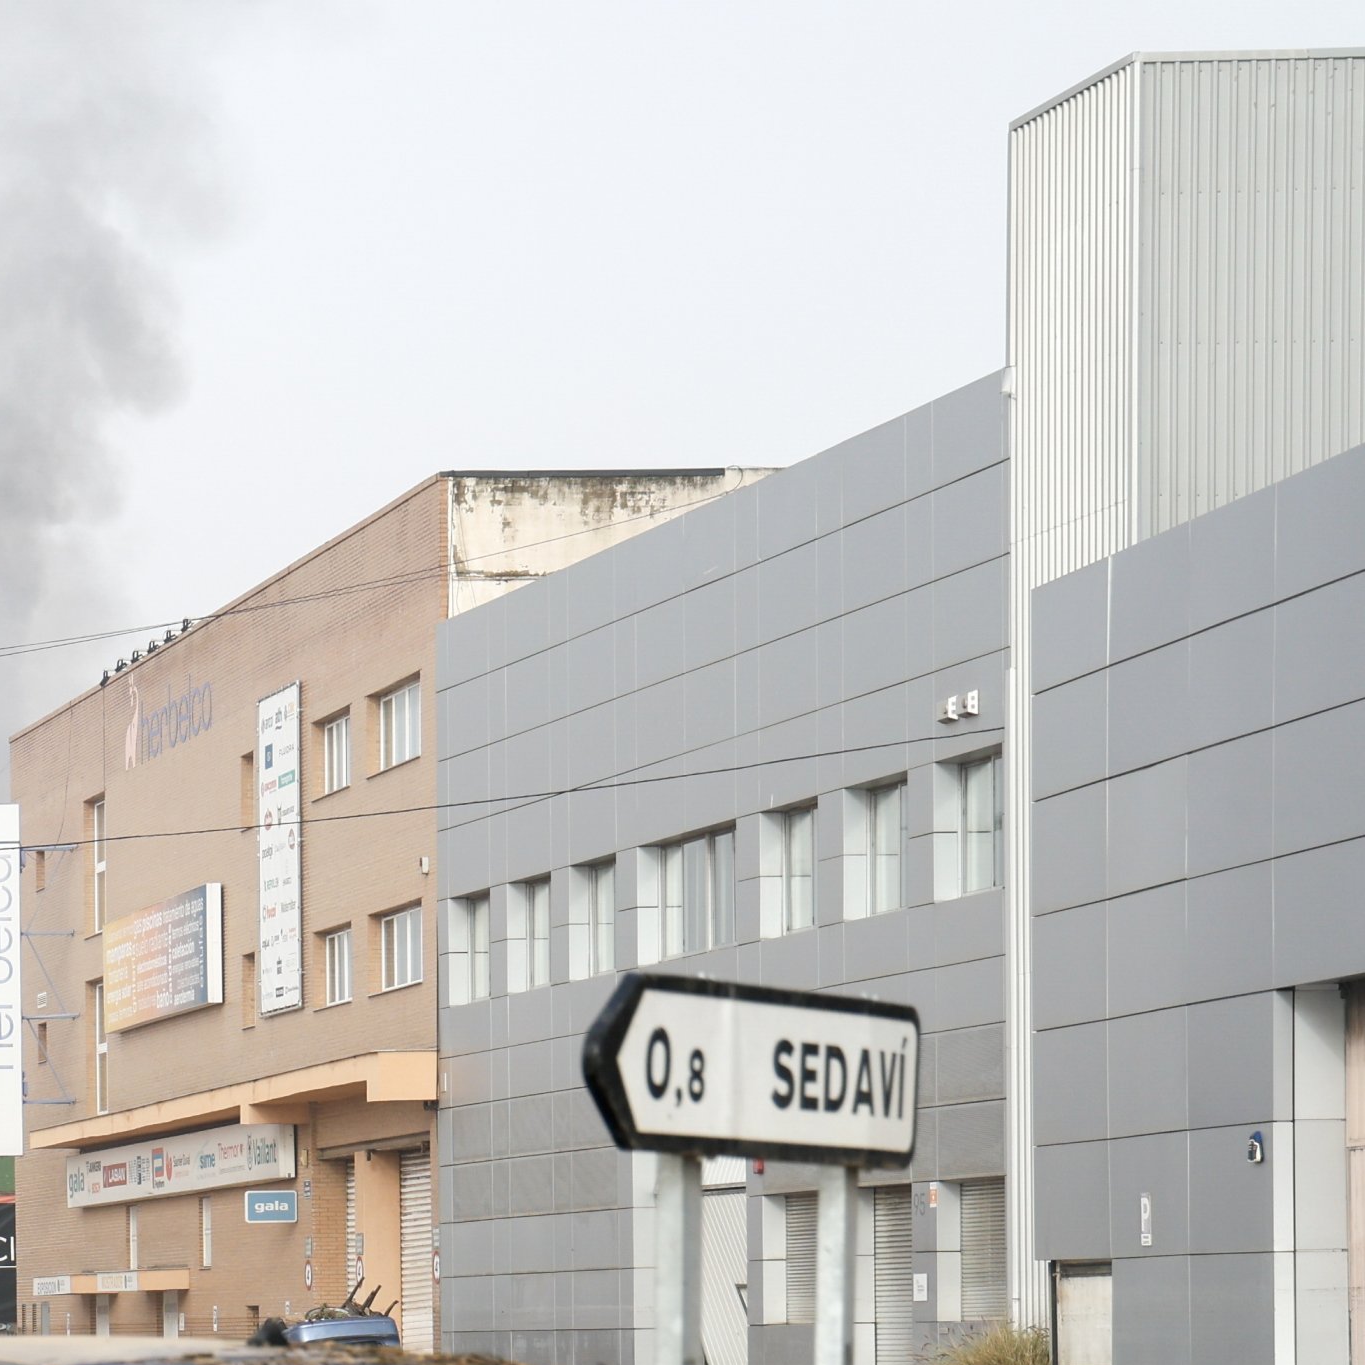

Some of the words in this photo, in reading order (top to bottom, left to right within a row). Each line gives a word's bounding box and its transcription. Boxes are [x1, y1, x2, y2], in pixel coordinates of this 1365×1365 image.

[140, 672, 212, 765] herbelca
[646, 1027, 705, 1107] 0,8
[771, 1036, 908, 1121] SEDAVÍ
[199, 1152, 216, 1170] sime
[217, 1142, 240, 1162] Thermor
[252, 1137, 277, 1166] Vaillant
[69, 1166, 84, 1199] gala
[254, 1200, 289, 1214] gala
[913, 1193, 926, 1216] 95
